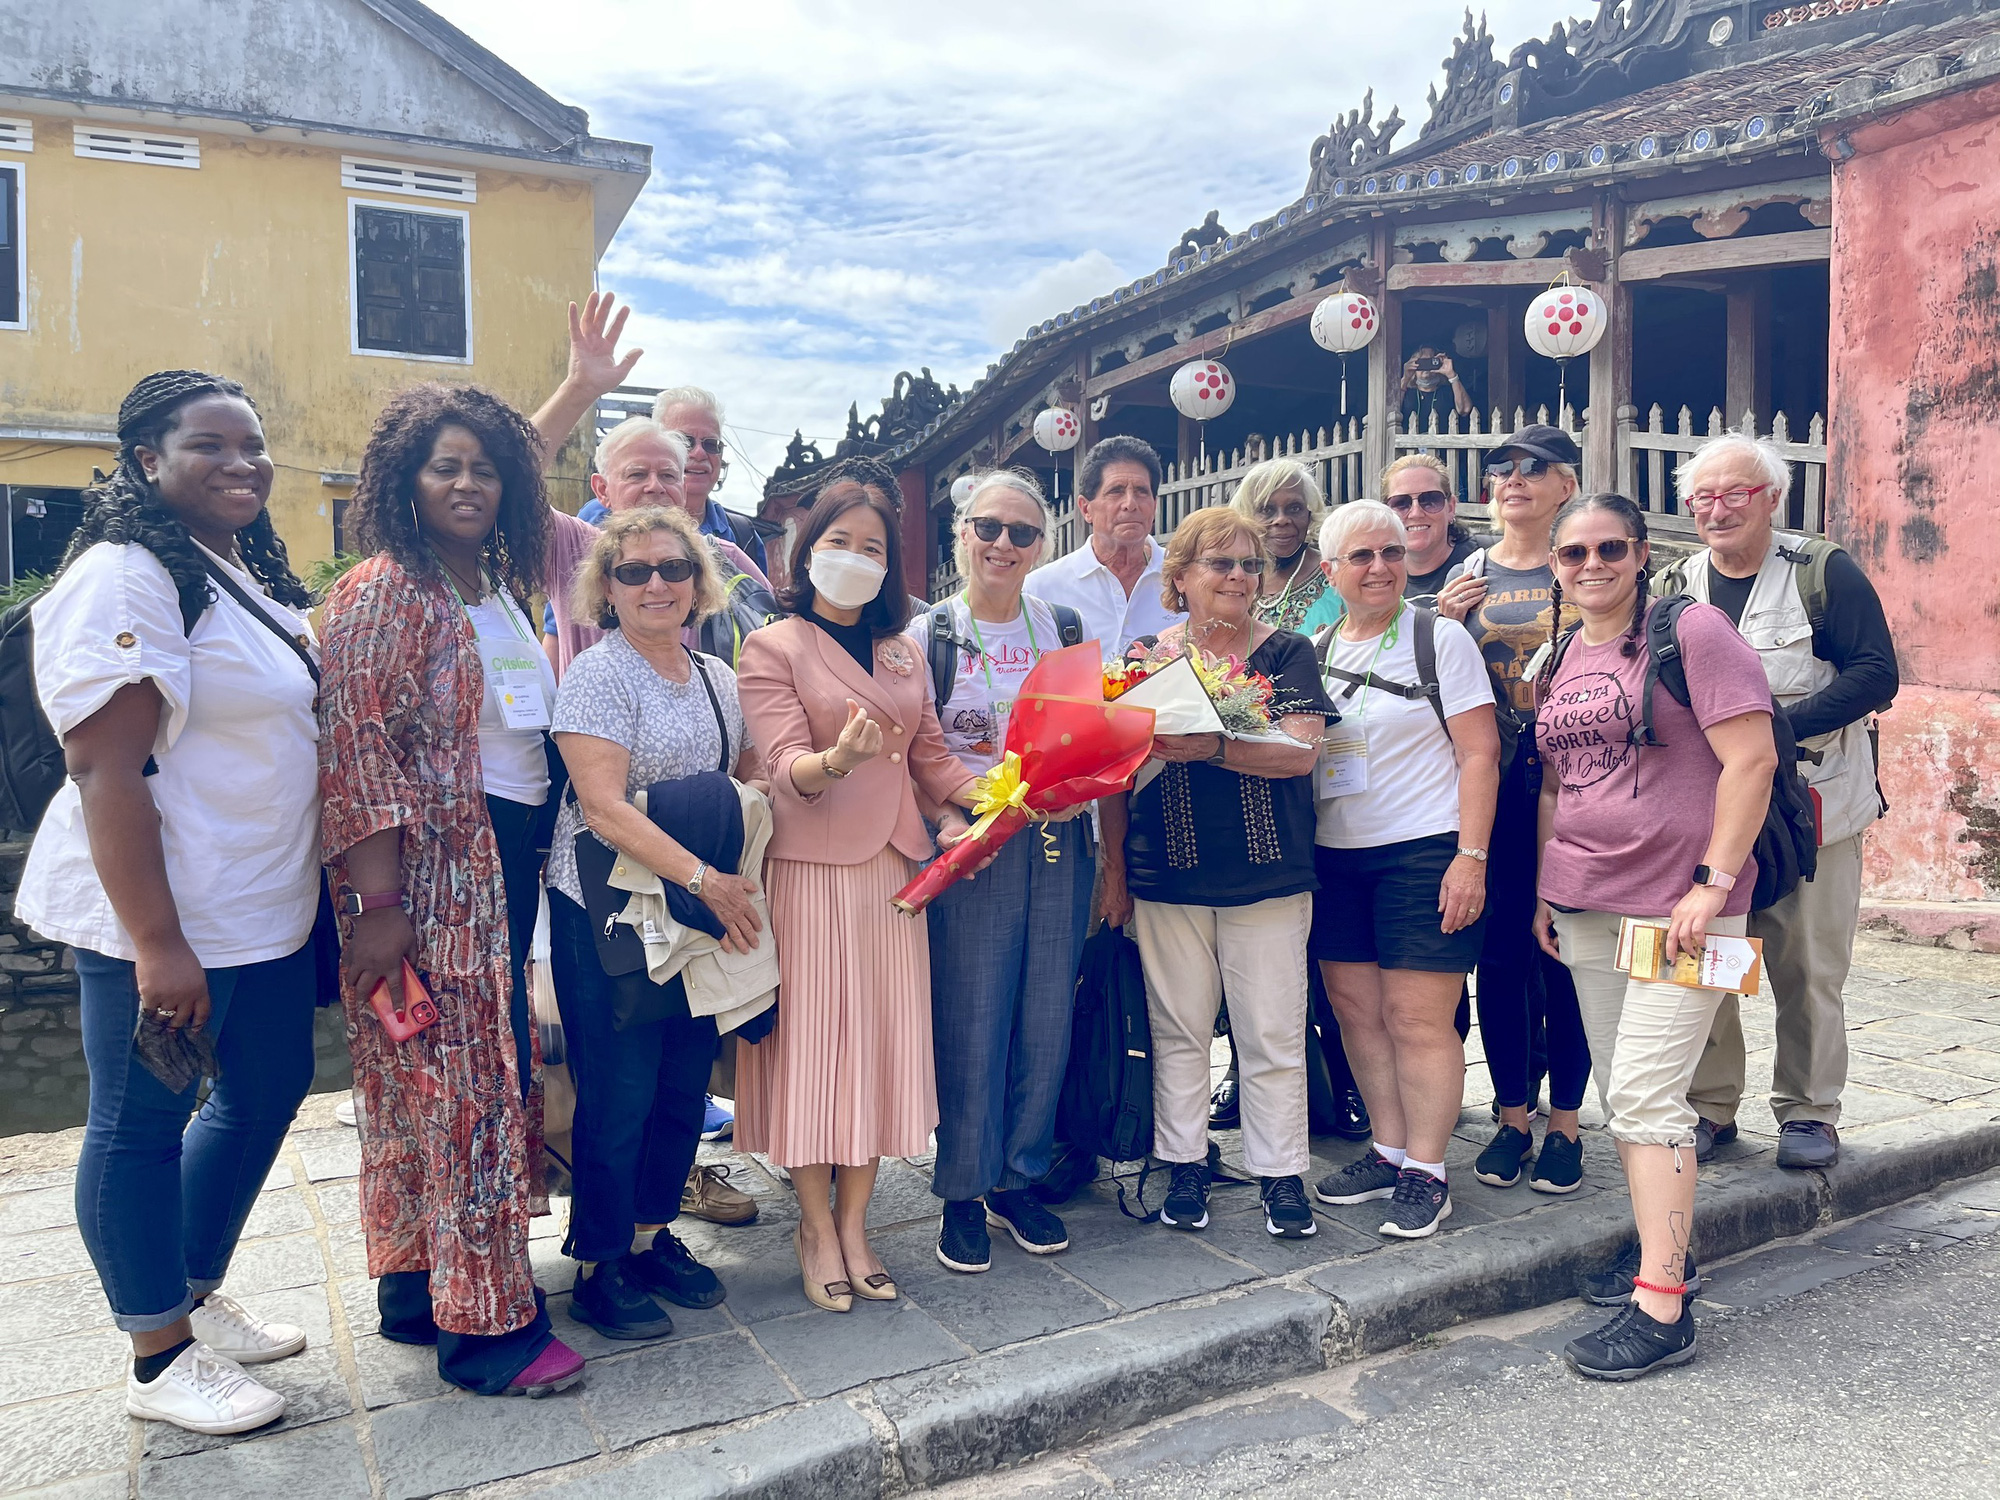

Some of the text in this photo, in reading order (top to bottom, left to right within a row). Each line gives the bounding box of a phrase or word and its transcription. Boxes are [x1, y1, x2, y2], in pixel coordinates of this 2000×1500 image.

[996, 666, 1029, 675] Vietnam
[1536, 695, 1635, 739] Sweet
[1546, 729, 1607, 753] SORTA
